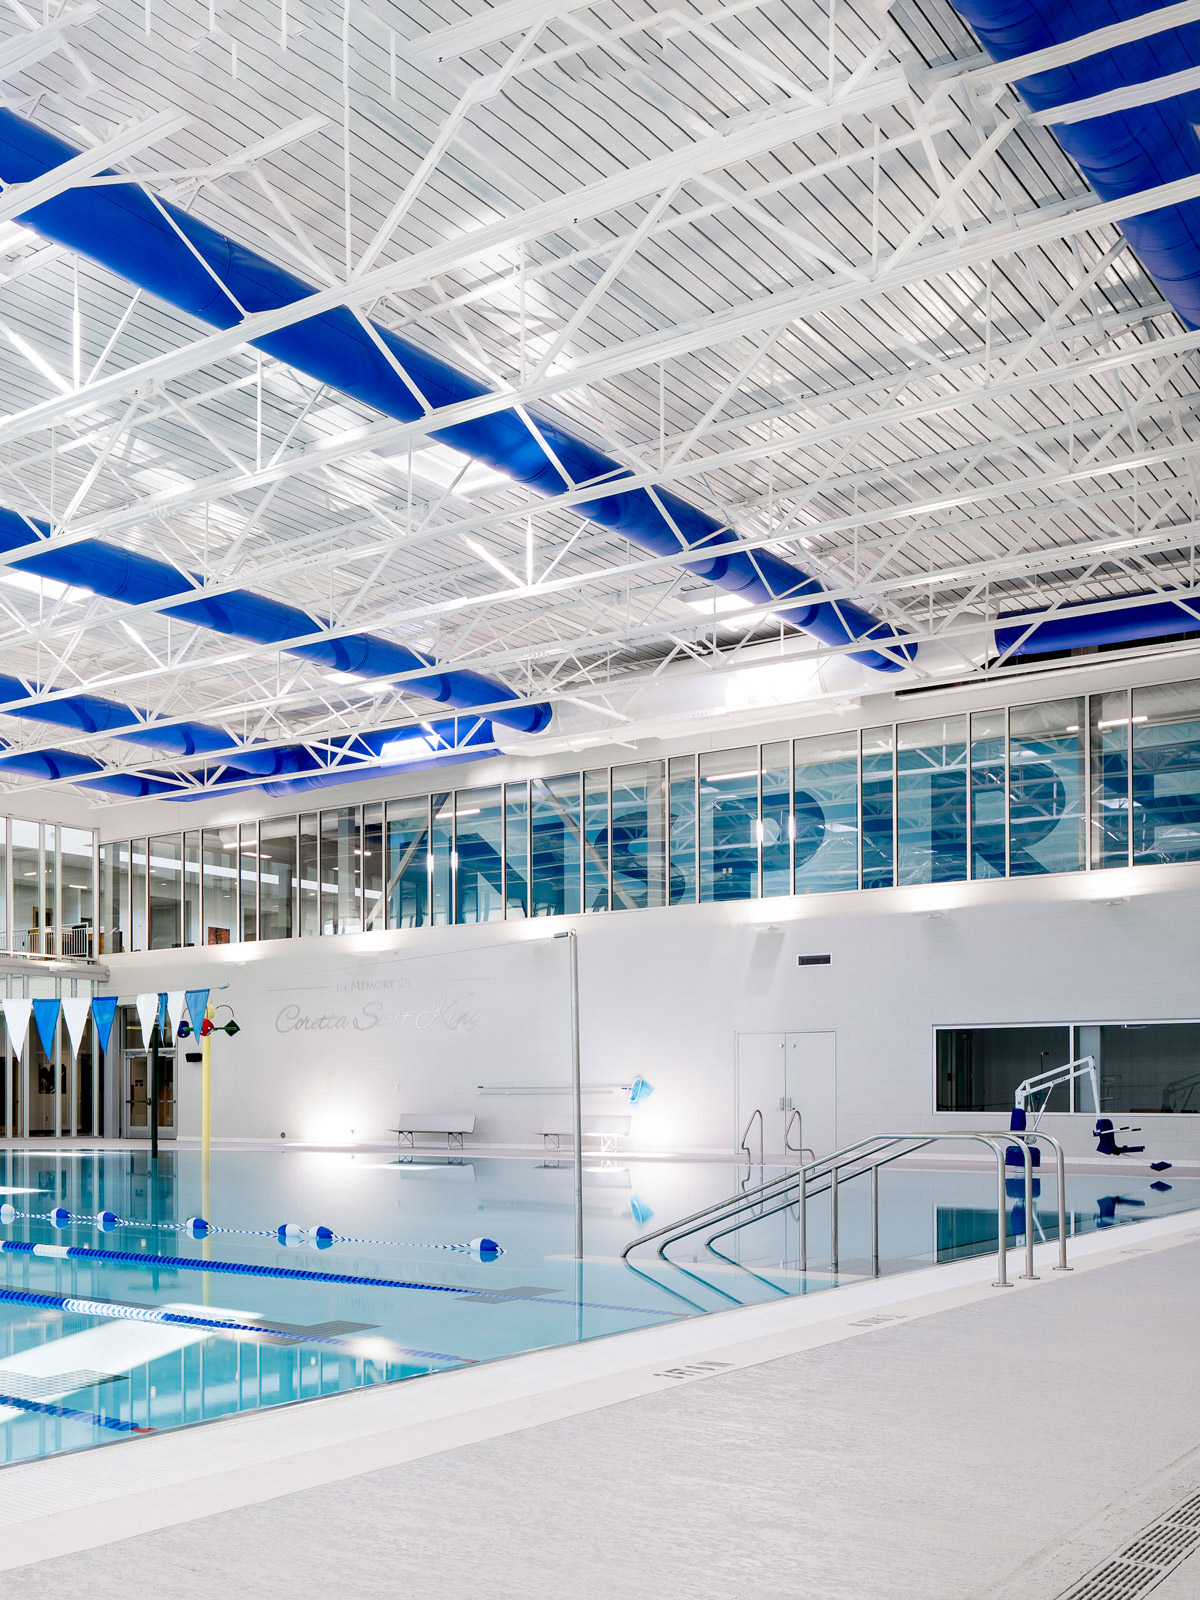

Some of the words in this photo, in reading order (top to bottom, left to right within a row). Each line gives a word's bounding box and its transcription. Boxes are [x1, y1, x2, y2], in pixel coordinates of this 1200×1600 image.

[337, 982, 347, 991] IN
[398, 978, 412, 989] OF
[275, 1004, 350, 1033] Coretta
[352, 1000, 413, 1032] Scott
[415, 992, 482, 1033] King
[663, 1368, 704, 1376] FT
